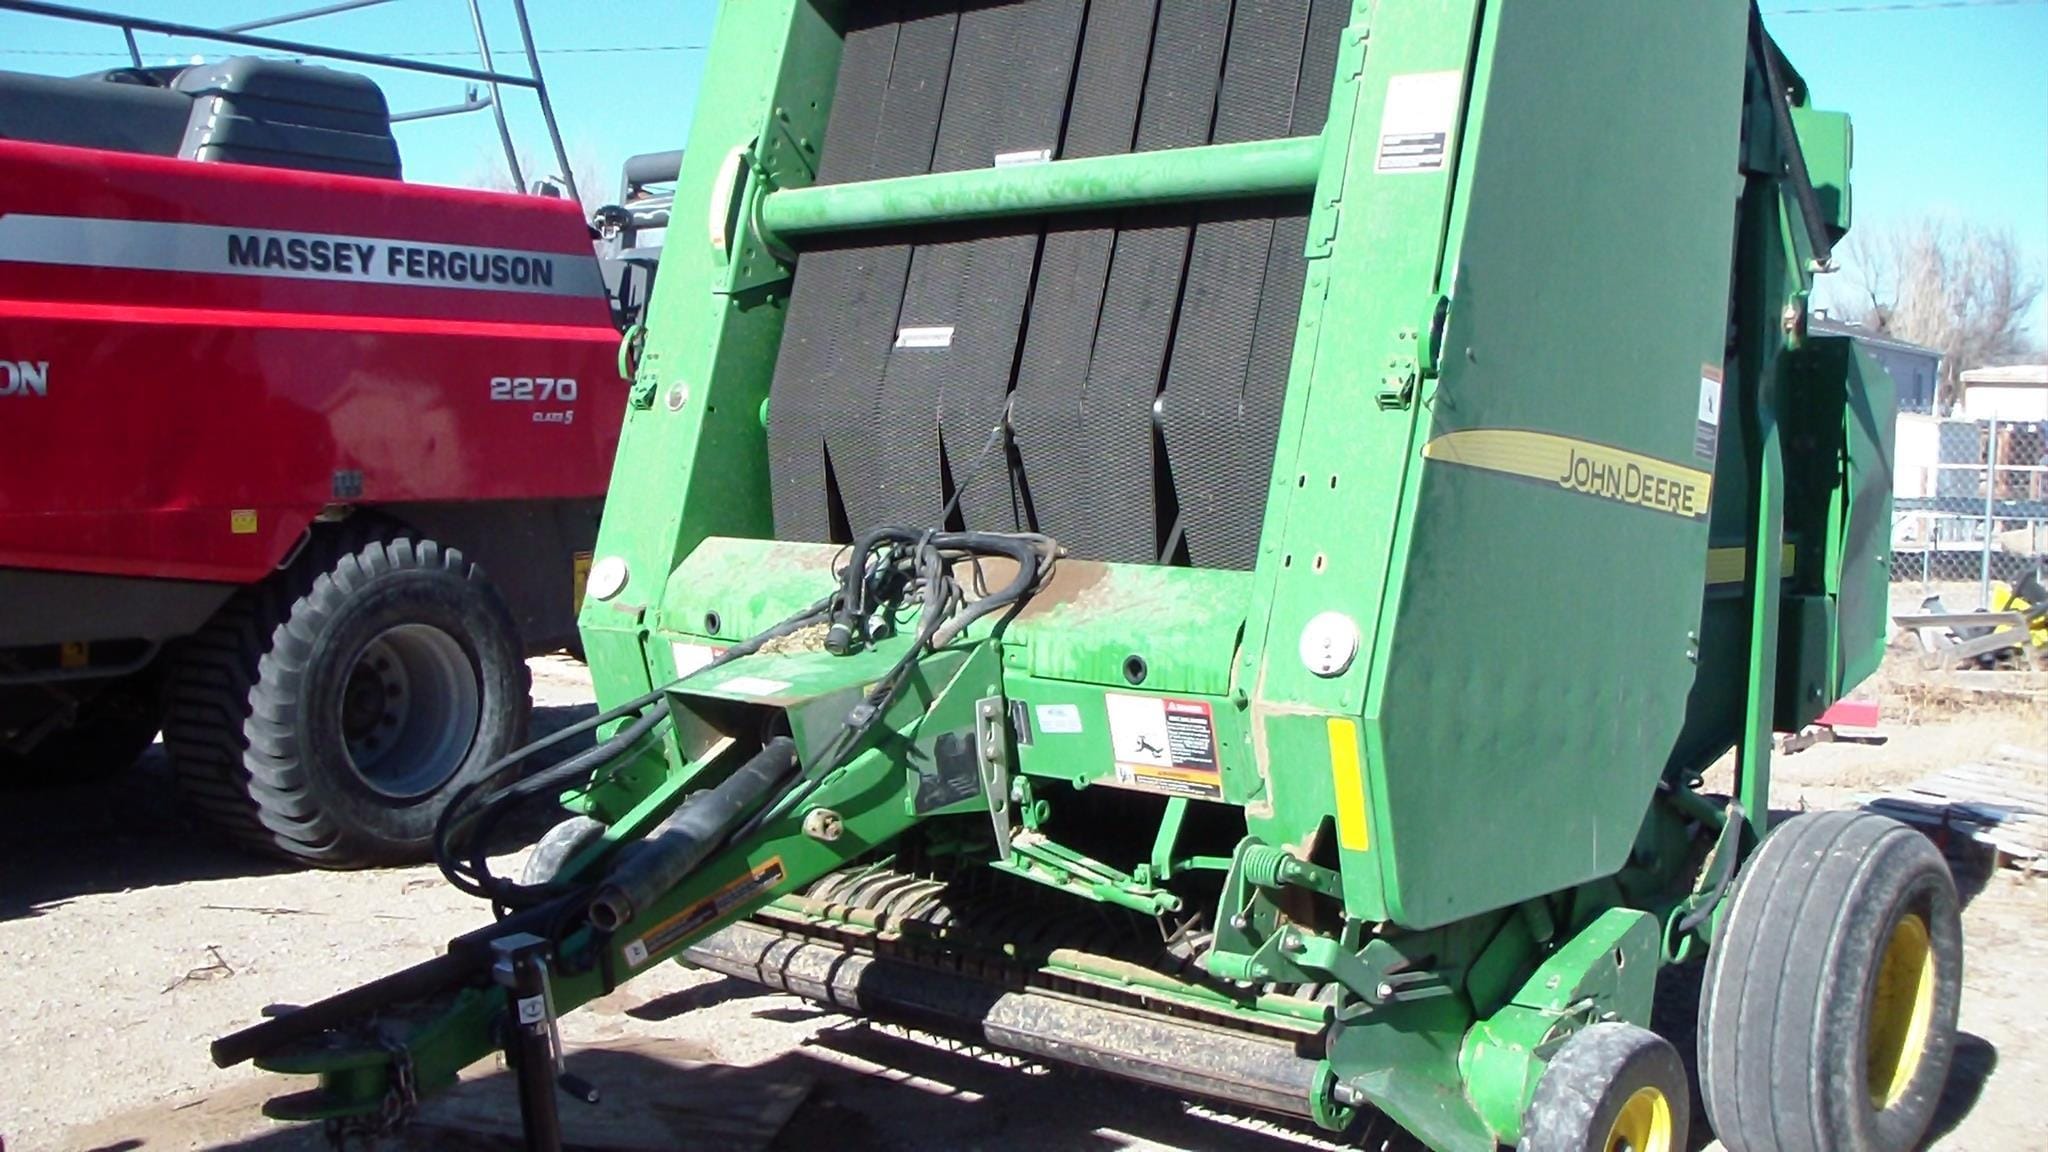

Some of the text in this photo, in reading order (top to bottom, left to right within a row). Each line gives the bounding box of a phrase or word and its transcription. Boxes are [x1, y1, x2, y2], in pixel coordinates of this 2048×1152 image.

[228, 234, 553, 287] MASSEY FERGUSON
[490, 377, 578, 401] 2270
[563, 409, 574, 425] 5
[1560, 448, 1696, 512] JOHN DEERE
